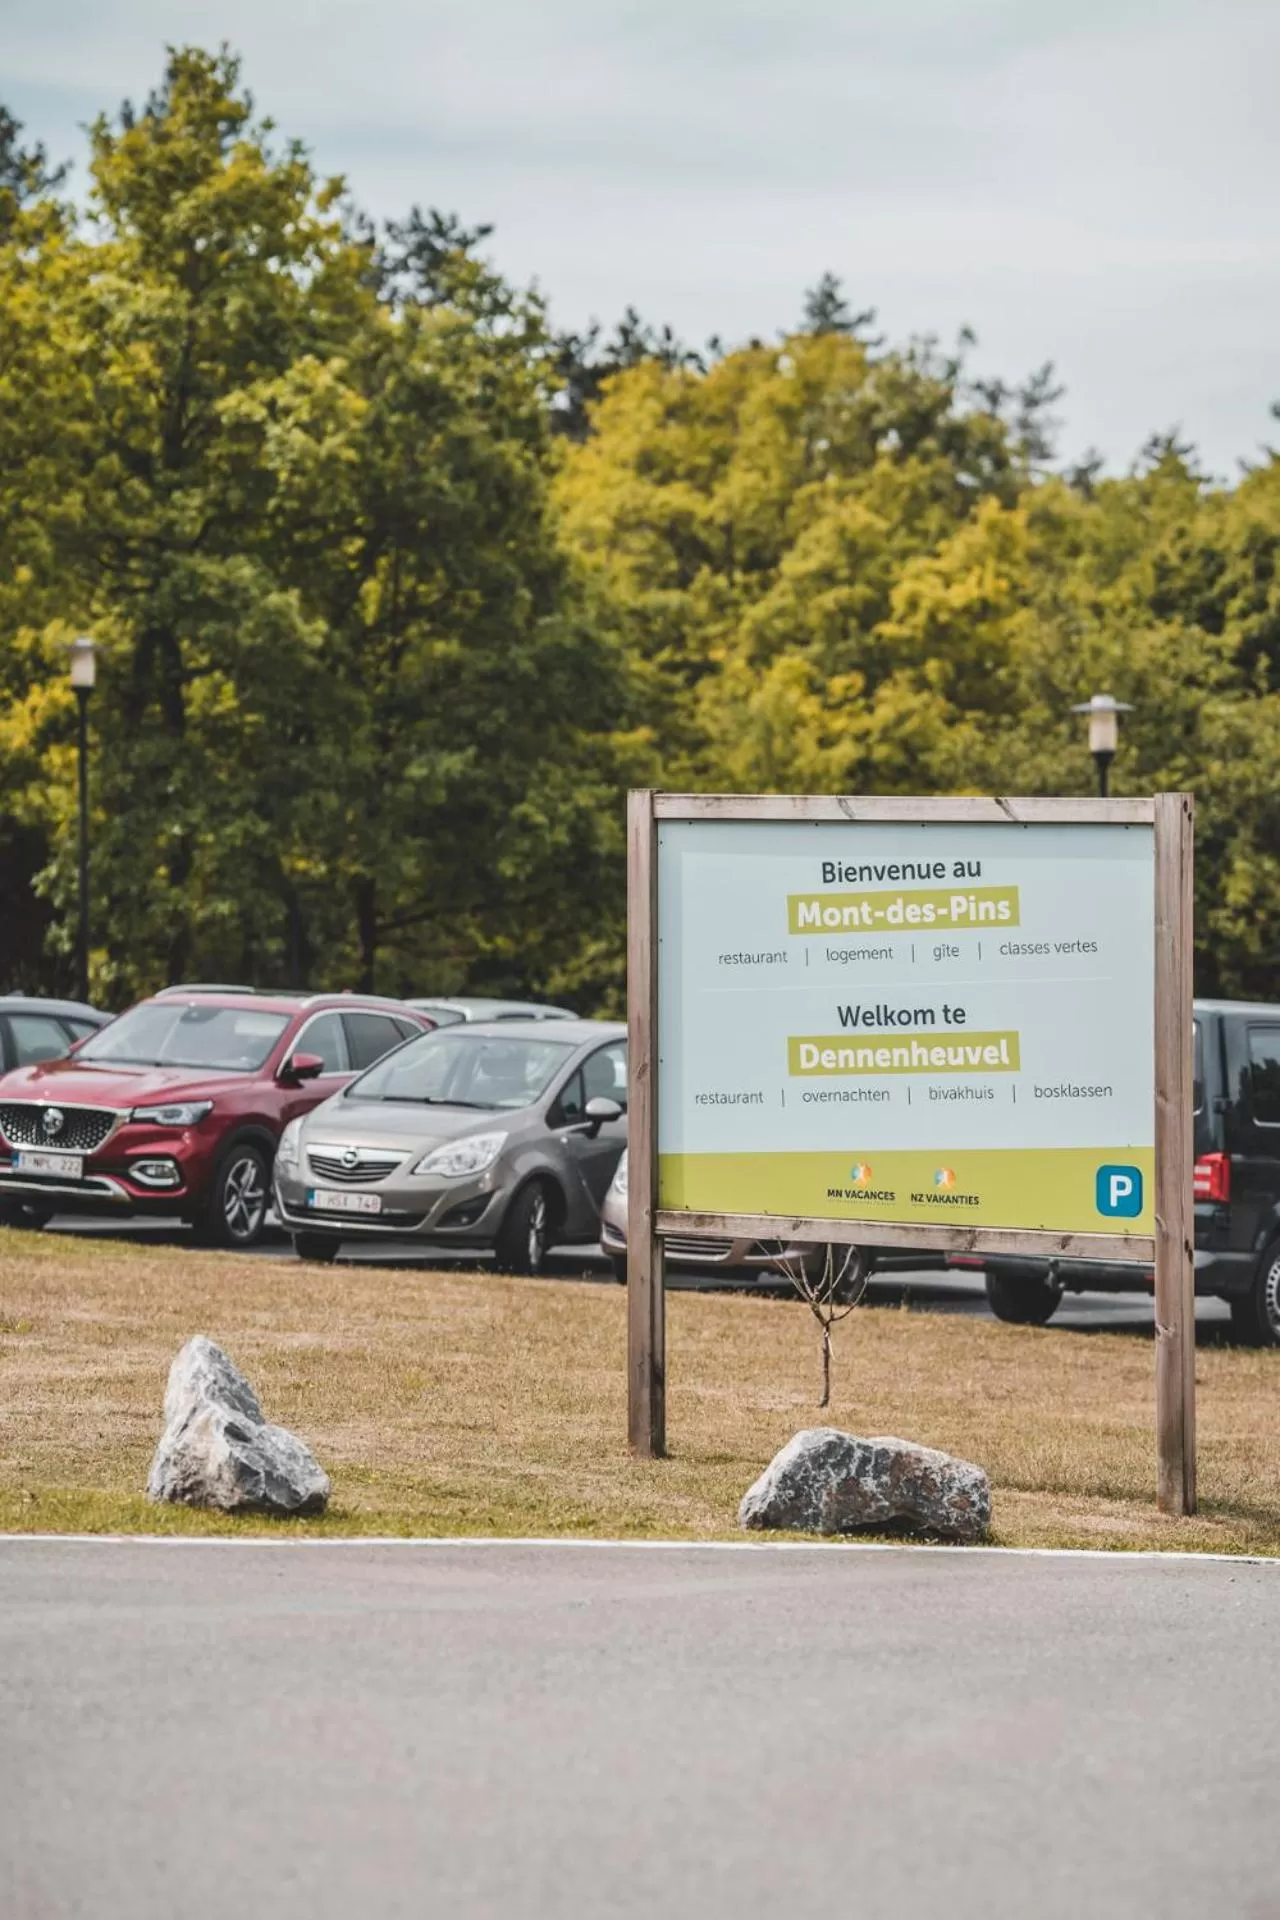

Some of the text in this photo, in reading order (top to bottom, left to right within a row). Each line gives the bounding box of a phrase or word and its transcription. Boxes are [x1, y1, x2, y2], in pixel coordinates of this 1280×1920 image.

[821, 860, 981, 884] Bienvenue au
[797, 895, 1011, 927] Mont-des-Pins
[718, 950, 788, 965] restaurant
[826, 947, 893, 964] logement
[999, 941, 1051, 956] classes
[1054, 939, 1098, 954] vertes
[837, 1004, 966, 1027] Welkom te
[799, 1040, 1010, 1068] Dennenheuvel
[695, 1083, 1113, 1105] restaurant overnachten bivakhuis bosklassen
[827, 1188, 896, 1202] MN VACANCES
[910, 1193, 924, 1203] NZ
[925, 1193, 980, 1206] VAKANTIES
[1109, 1175, 1133, 1207] P
